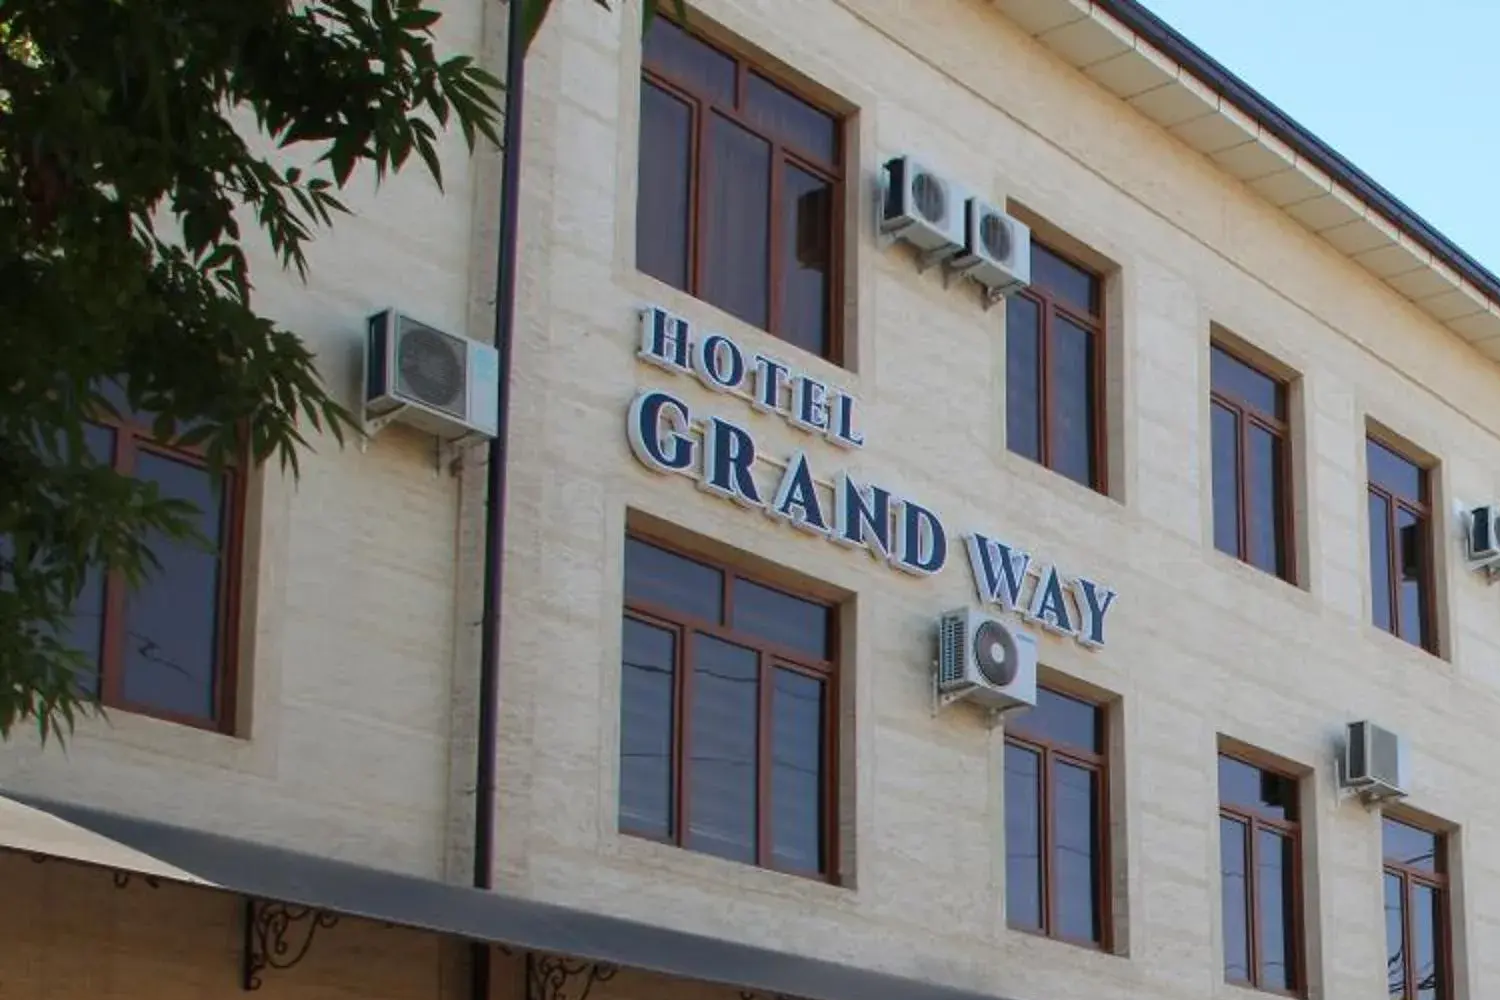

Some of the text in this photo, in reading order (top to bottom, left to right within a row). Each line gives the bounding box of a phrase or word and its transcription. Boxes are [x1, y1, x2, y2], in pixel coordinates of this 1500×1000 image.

[640, 306, 863, 446] HOTEL
[629, 389, 1117, 650] GRAND WAY
